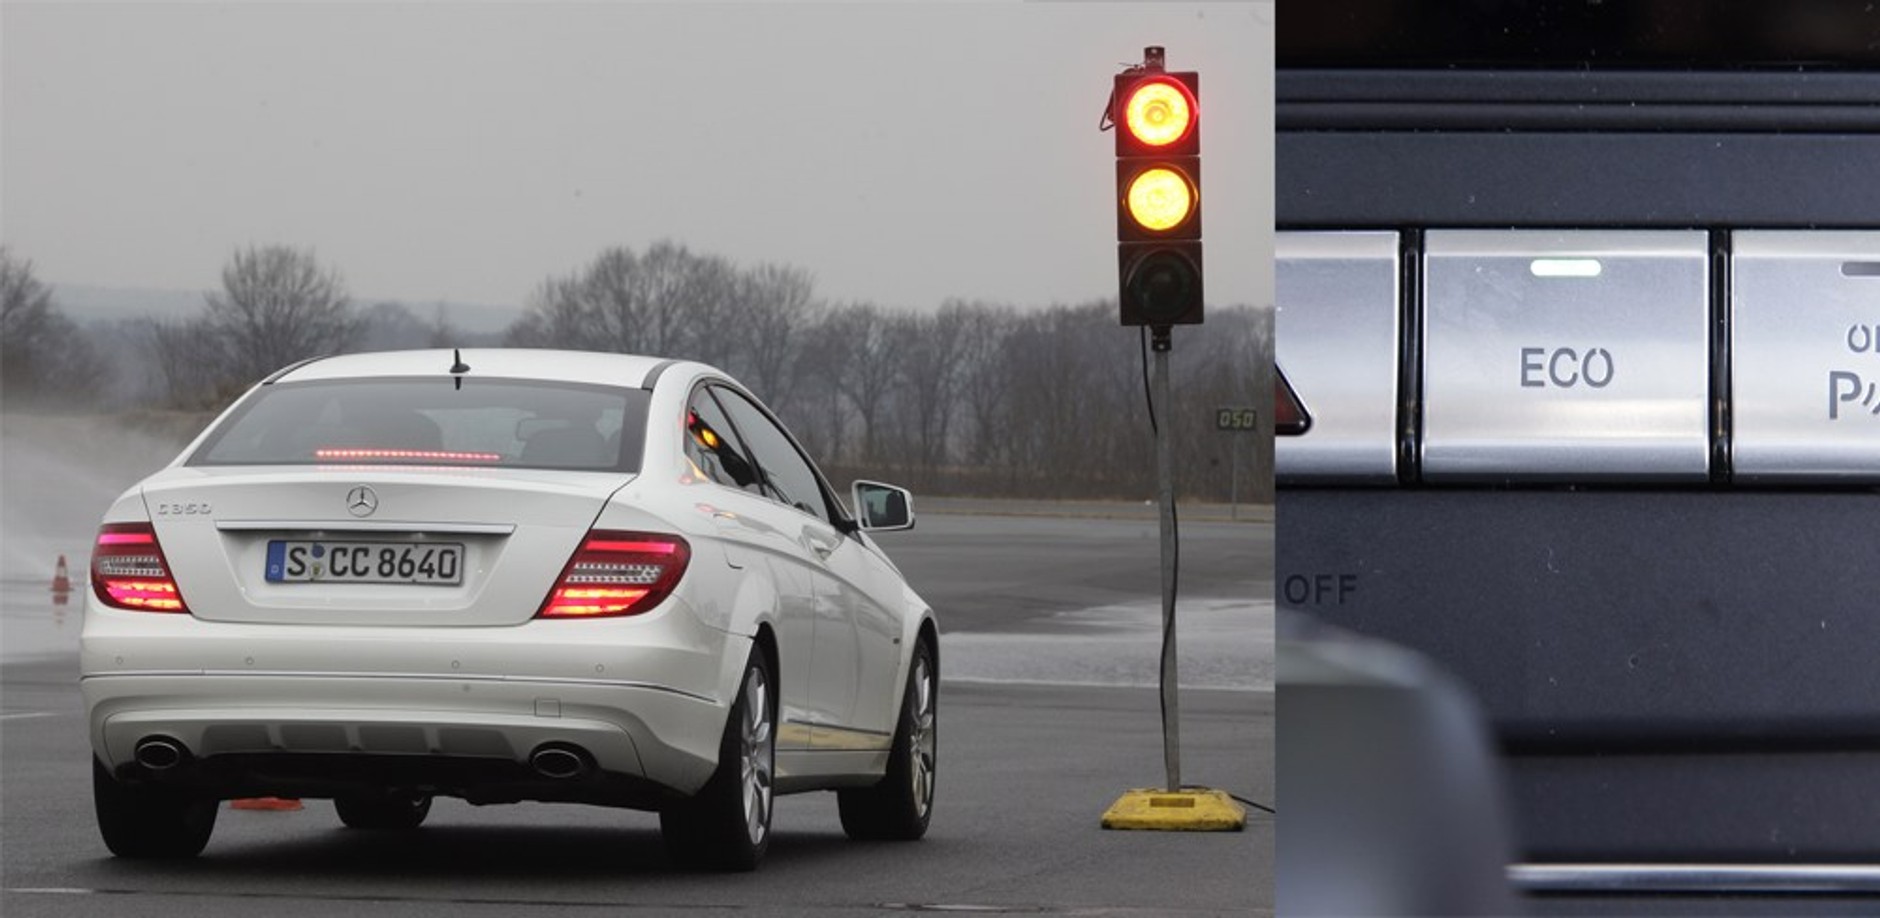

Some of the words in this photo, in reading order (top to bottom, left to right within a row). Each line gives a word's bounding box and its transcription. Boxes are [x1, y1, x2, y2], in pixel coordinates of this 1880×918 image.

[1847, 324, 1880, 353] O
[1520, 347, 1615, 388] ECO
[287, 547, 307, 576] S
[329, 547, 370, 577] CC
[377, 548, 457, 579] 8640
[1284, 574, 1358, 605] OFF
